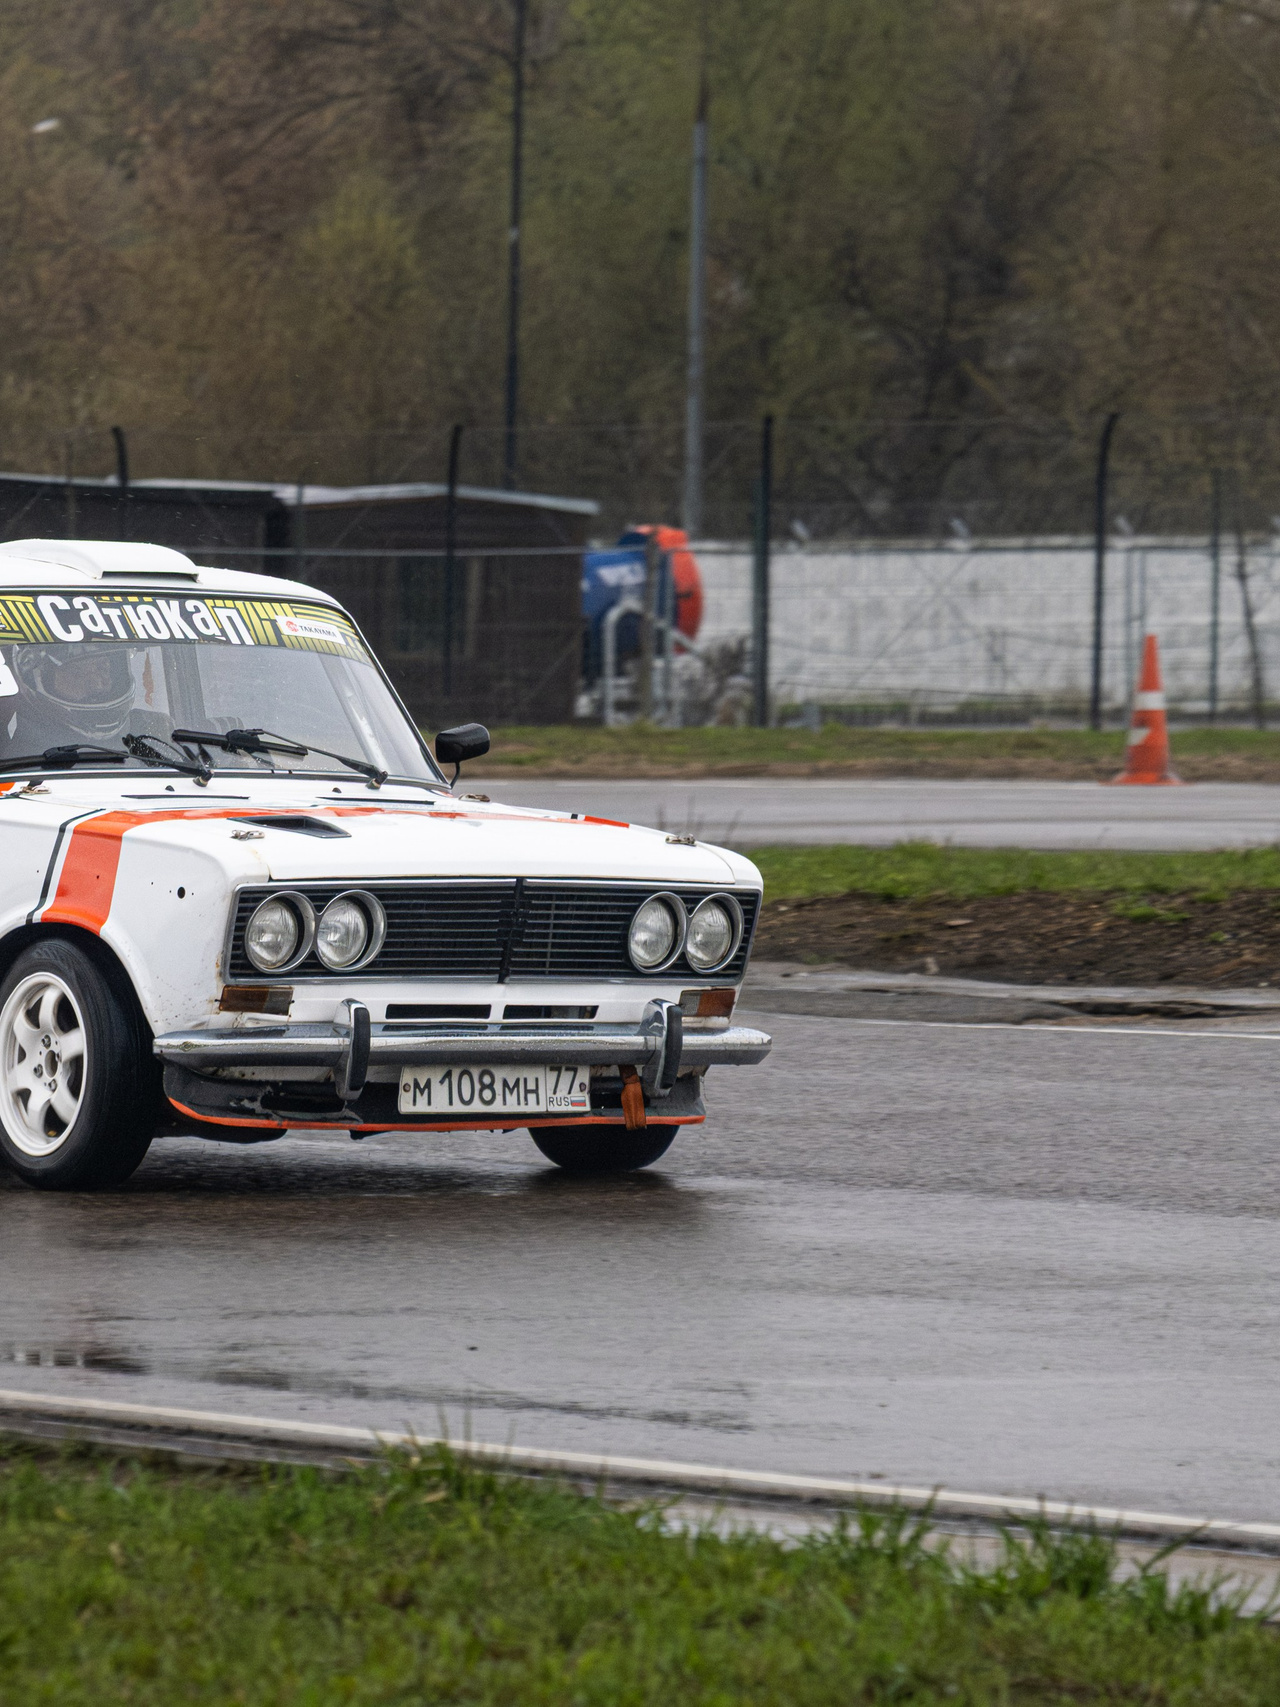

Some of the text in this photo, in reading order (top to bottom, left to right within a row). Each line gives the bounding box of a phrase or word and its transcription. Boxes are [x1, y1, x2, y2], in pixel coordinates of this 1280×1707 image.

[299, 625, 338, 638] TAKAYAMA
[549, 1066, 578, 1095] 77
[548, 1096, 570, 1107] RUS
